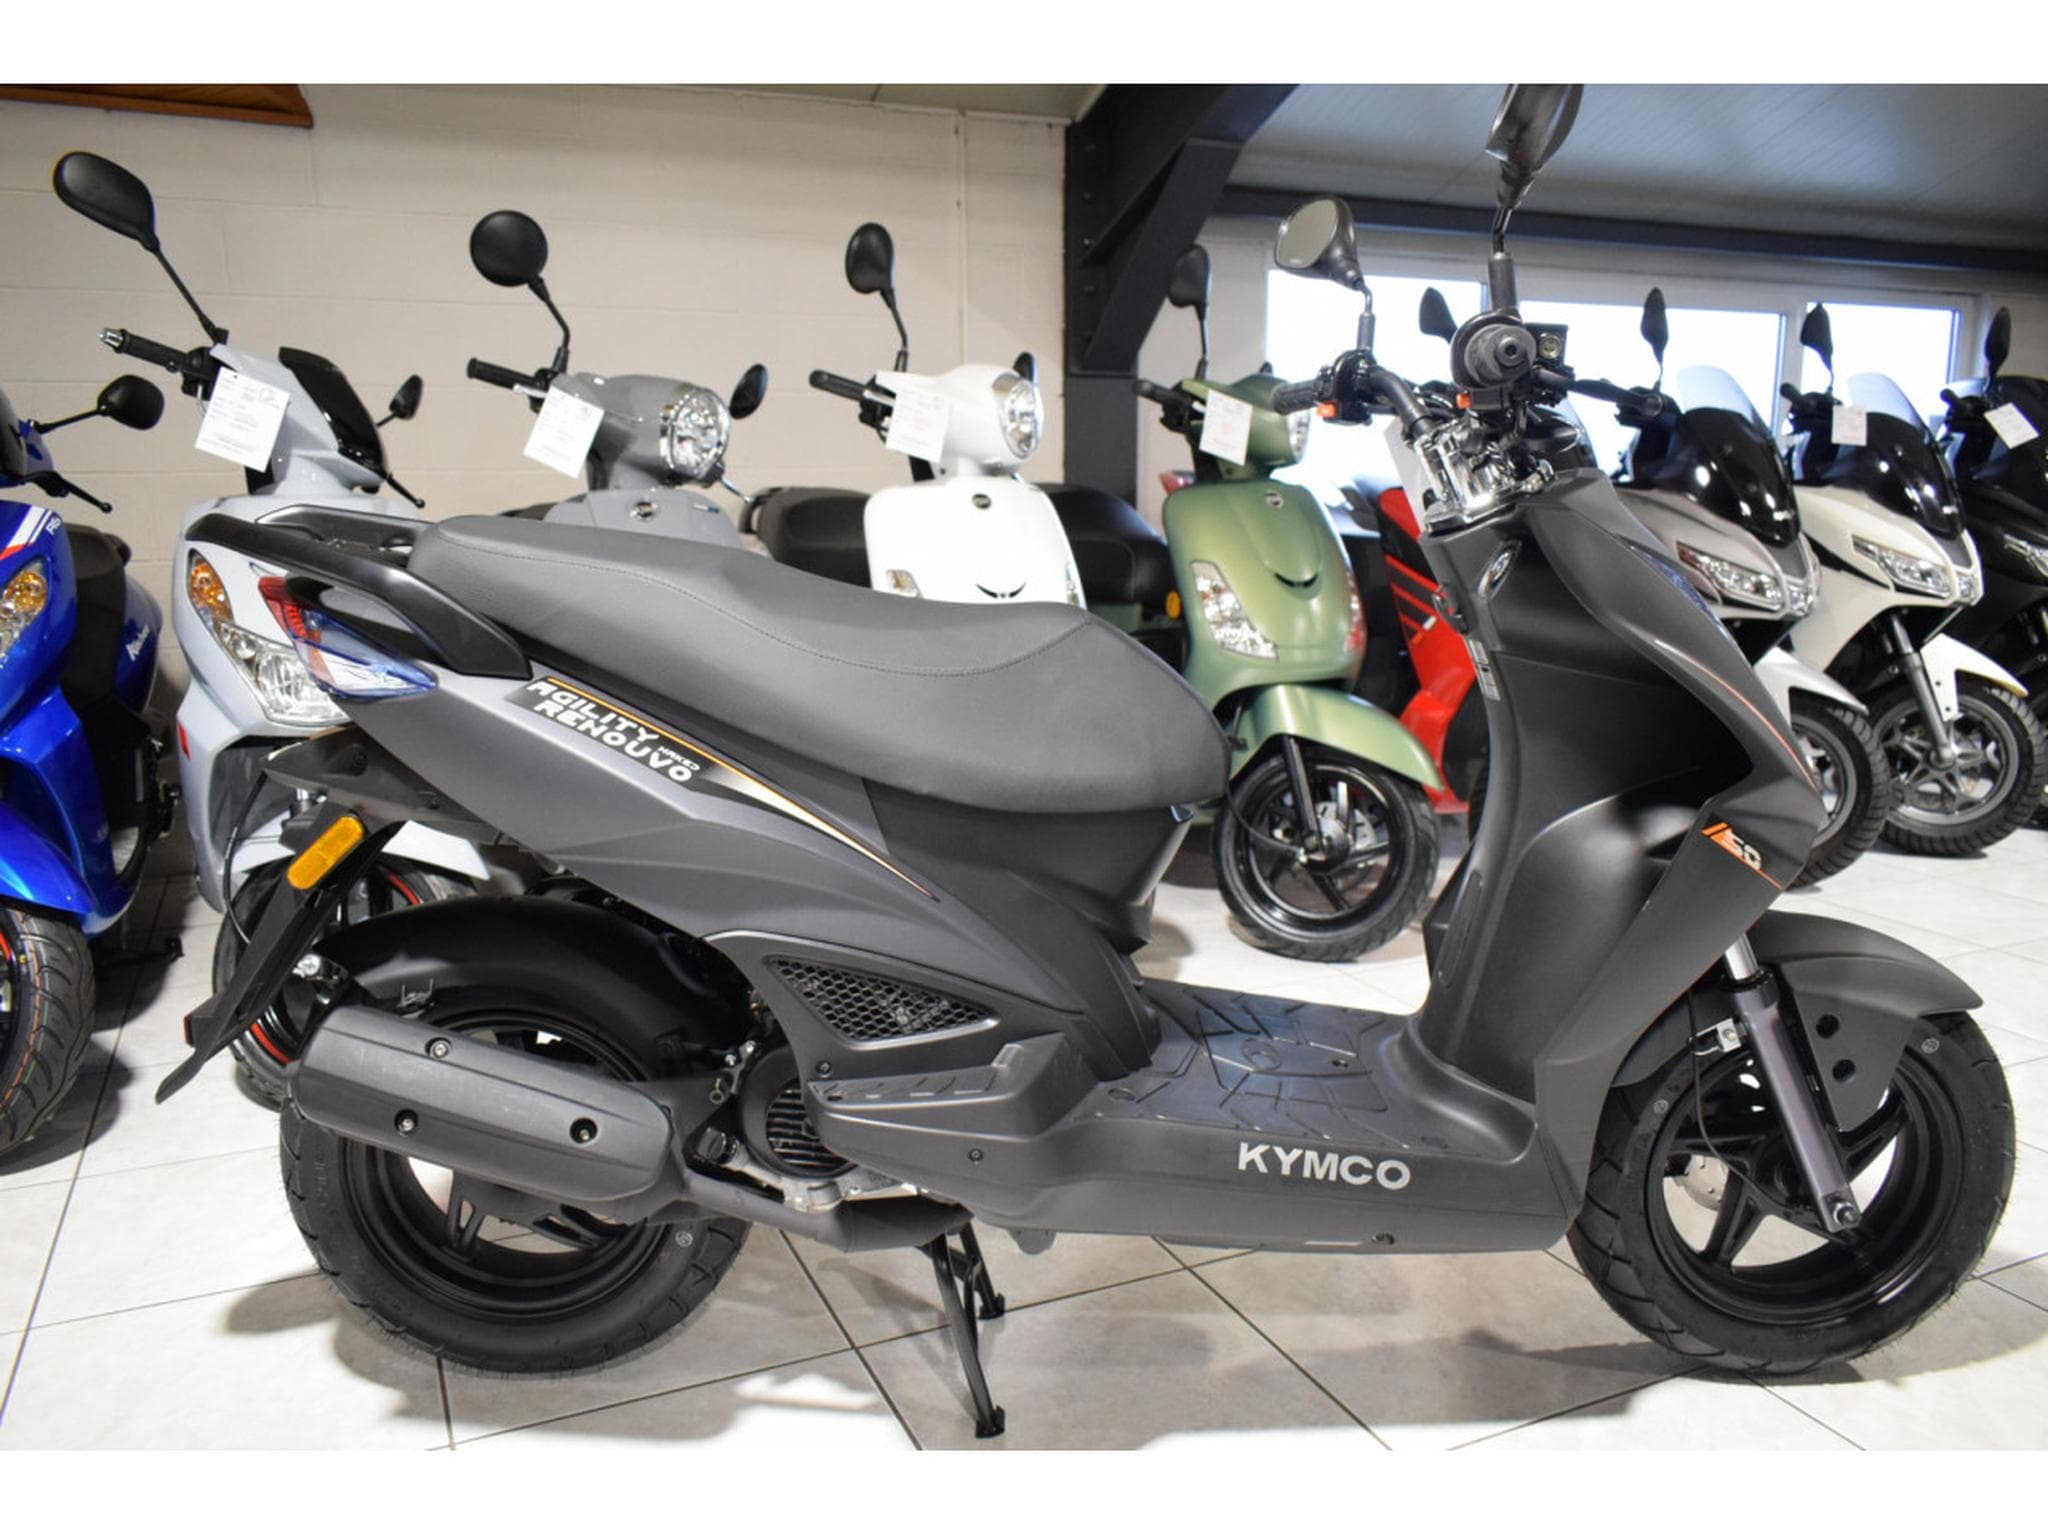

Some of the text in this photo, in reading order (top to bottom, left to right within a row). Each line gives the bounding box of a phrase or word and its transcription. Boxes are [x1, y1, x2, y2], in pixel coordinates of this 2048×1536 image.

[527, 681, 660, 742] AGILITY
[534, 700, 692, 782] RENOUVO
[657, 746, 701, 771] NAKED
[1238, 1142, 1411, 1190] KYMCO
